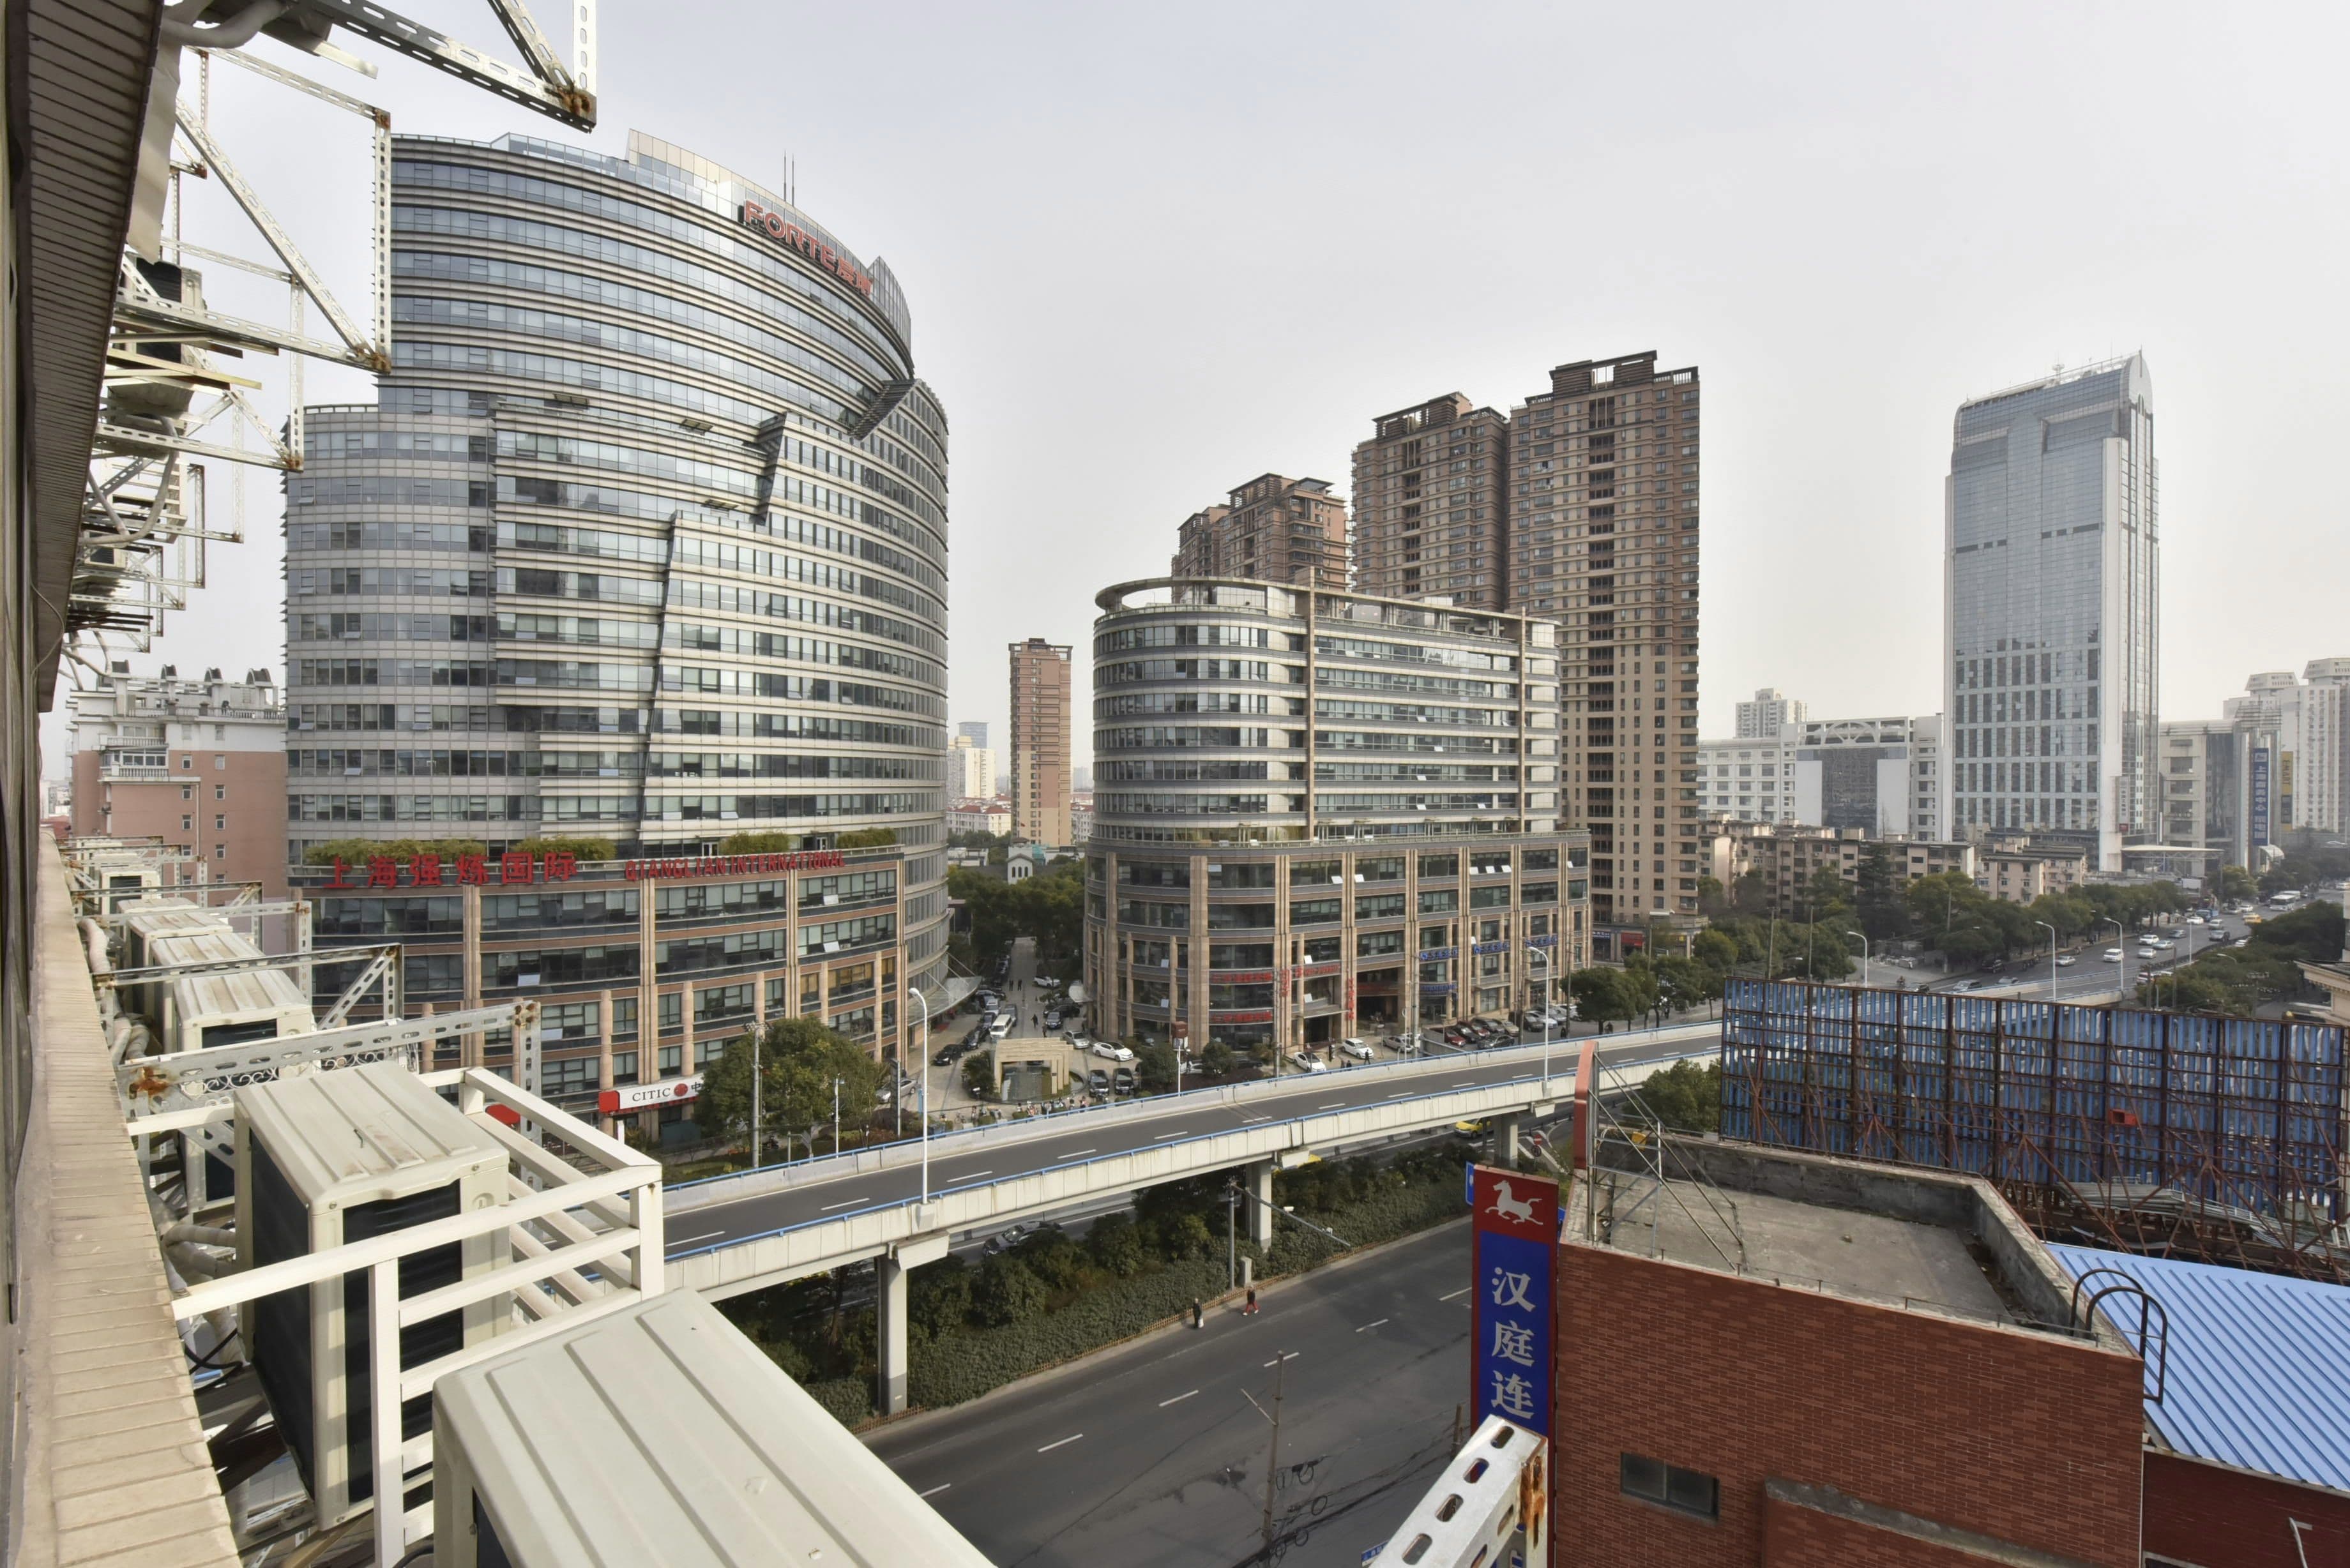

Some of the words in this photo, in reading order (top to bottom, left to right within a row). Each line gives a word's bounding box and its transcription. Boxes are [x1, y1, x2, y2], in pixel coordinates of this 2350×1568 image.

[744, 200, 835, 272] FORTE
[625, 857, 727, 881] QIANGLIAN
[731, 850, 846, 874] INTERNATIONAL
[632, 1088, 671, 1102] CITIC
[1491, 1267, 1536, 1420] 汉庭连
